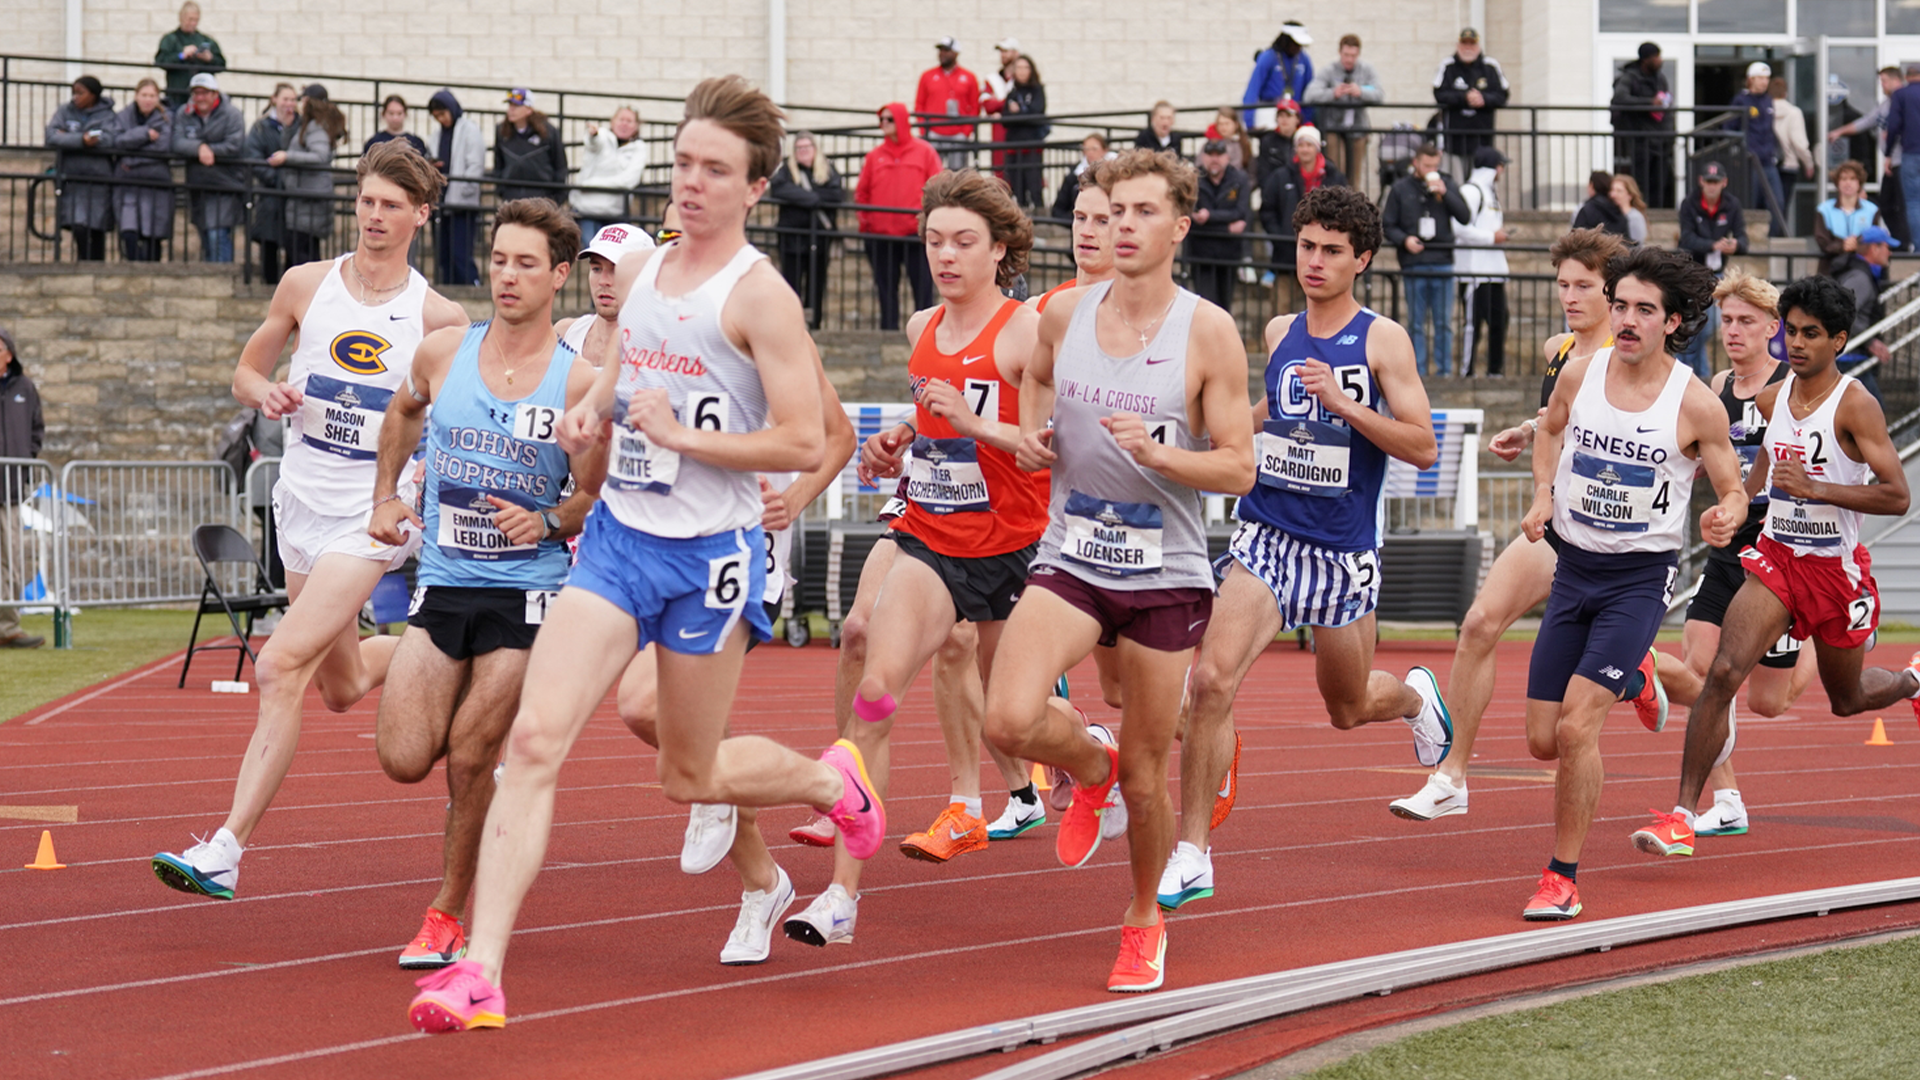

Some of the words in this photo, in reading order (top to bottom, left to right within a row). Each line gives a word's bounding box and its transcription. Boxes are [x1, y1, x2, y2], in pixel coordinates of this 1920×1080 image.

[970, 383, 990, 417] 7
[1060, 379, 1100, 405] UW-LA
[1105, 389, 1157, 415] CROSSE
[1341, 368, 1364, 405] 5
[325, 407, 365, 427] MASON
[525, 407, 556, 440] 13
[695, 396, 721, 431] 6
[324, 423, 360, 446] SHEA
[449, 427, 539, 468] JOHNS
[1573, 426, 1668, 465] GENESEO
[1809, 431, 1828, 465] 2
[1265, 454, 1342, 483] SCARDIGNO
[1287, 445, 1316, 462] MATT
[434, 447, 549, 497] HOPKINS
[1582, 497, 1632, 520] WILSON
[1586, 484, 1629, 502] CHARLIE
[1652, 481, 1670, 515] 4
[453, 513, 495, 530] EMMAN
[1094, 527, 1127, 544] ADAM
[1772, 516, 1840, 536] BISSOONDIAL
[453, 528, 515, 549] LEBLON
[1076, 539, 1144, 565] LOENSER
[715, 561, 740, 604] 6
[1352, 550, 1374, 587] 5
[1852, 601, 1869, 629] 2
